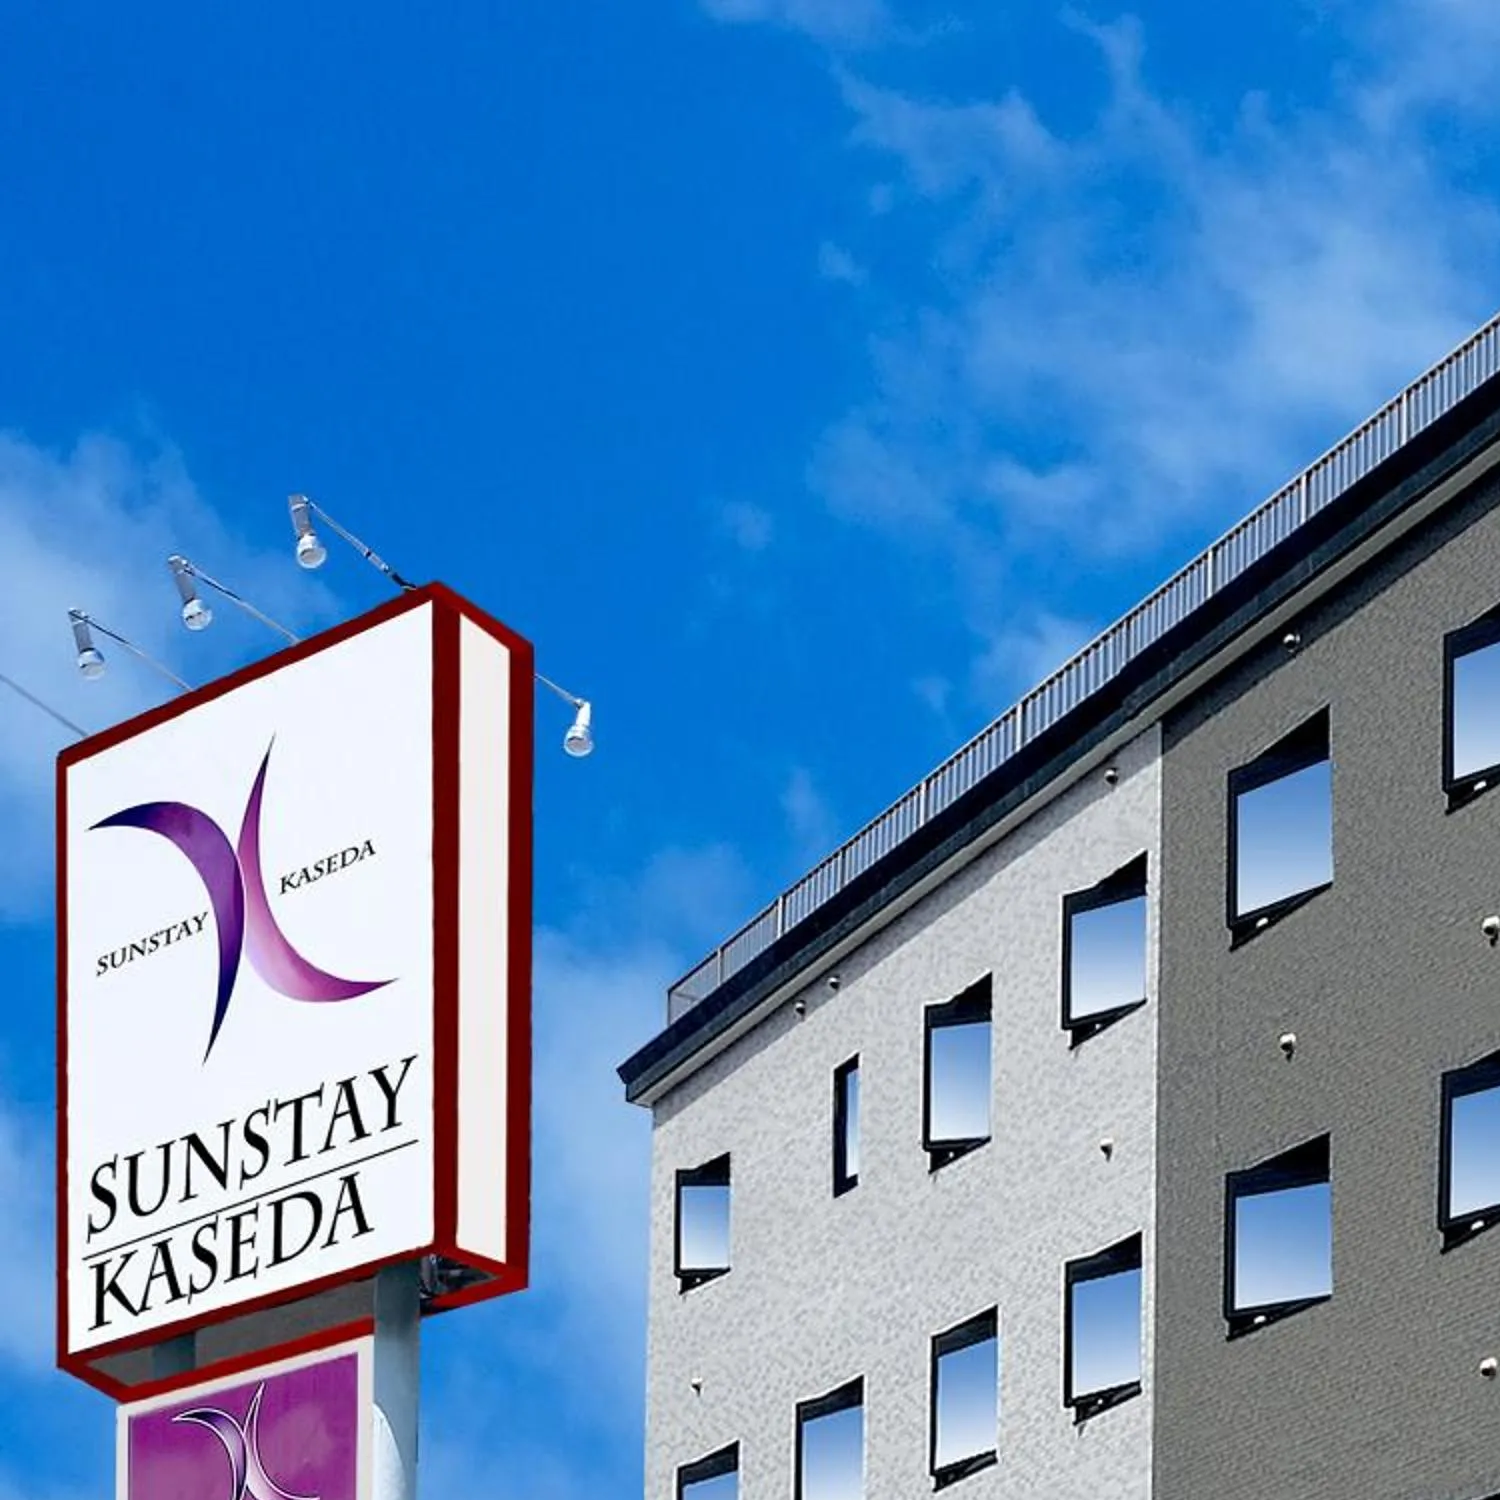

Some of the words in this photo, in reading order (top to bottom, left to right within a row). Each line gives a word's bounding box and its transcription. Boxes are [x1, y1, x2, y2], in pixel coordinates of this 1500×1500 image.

[279, 839, 377, 896] KASEDA
[95, 911, 209, 977] SUNSTAY
[86, 1054, 418, 1244] SUNSTAY
[88, 1171, 375, 1332] KASEDA
